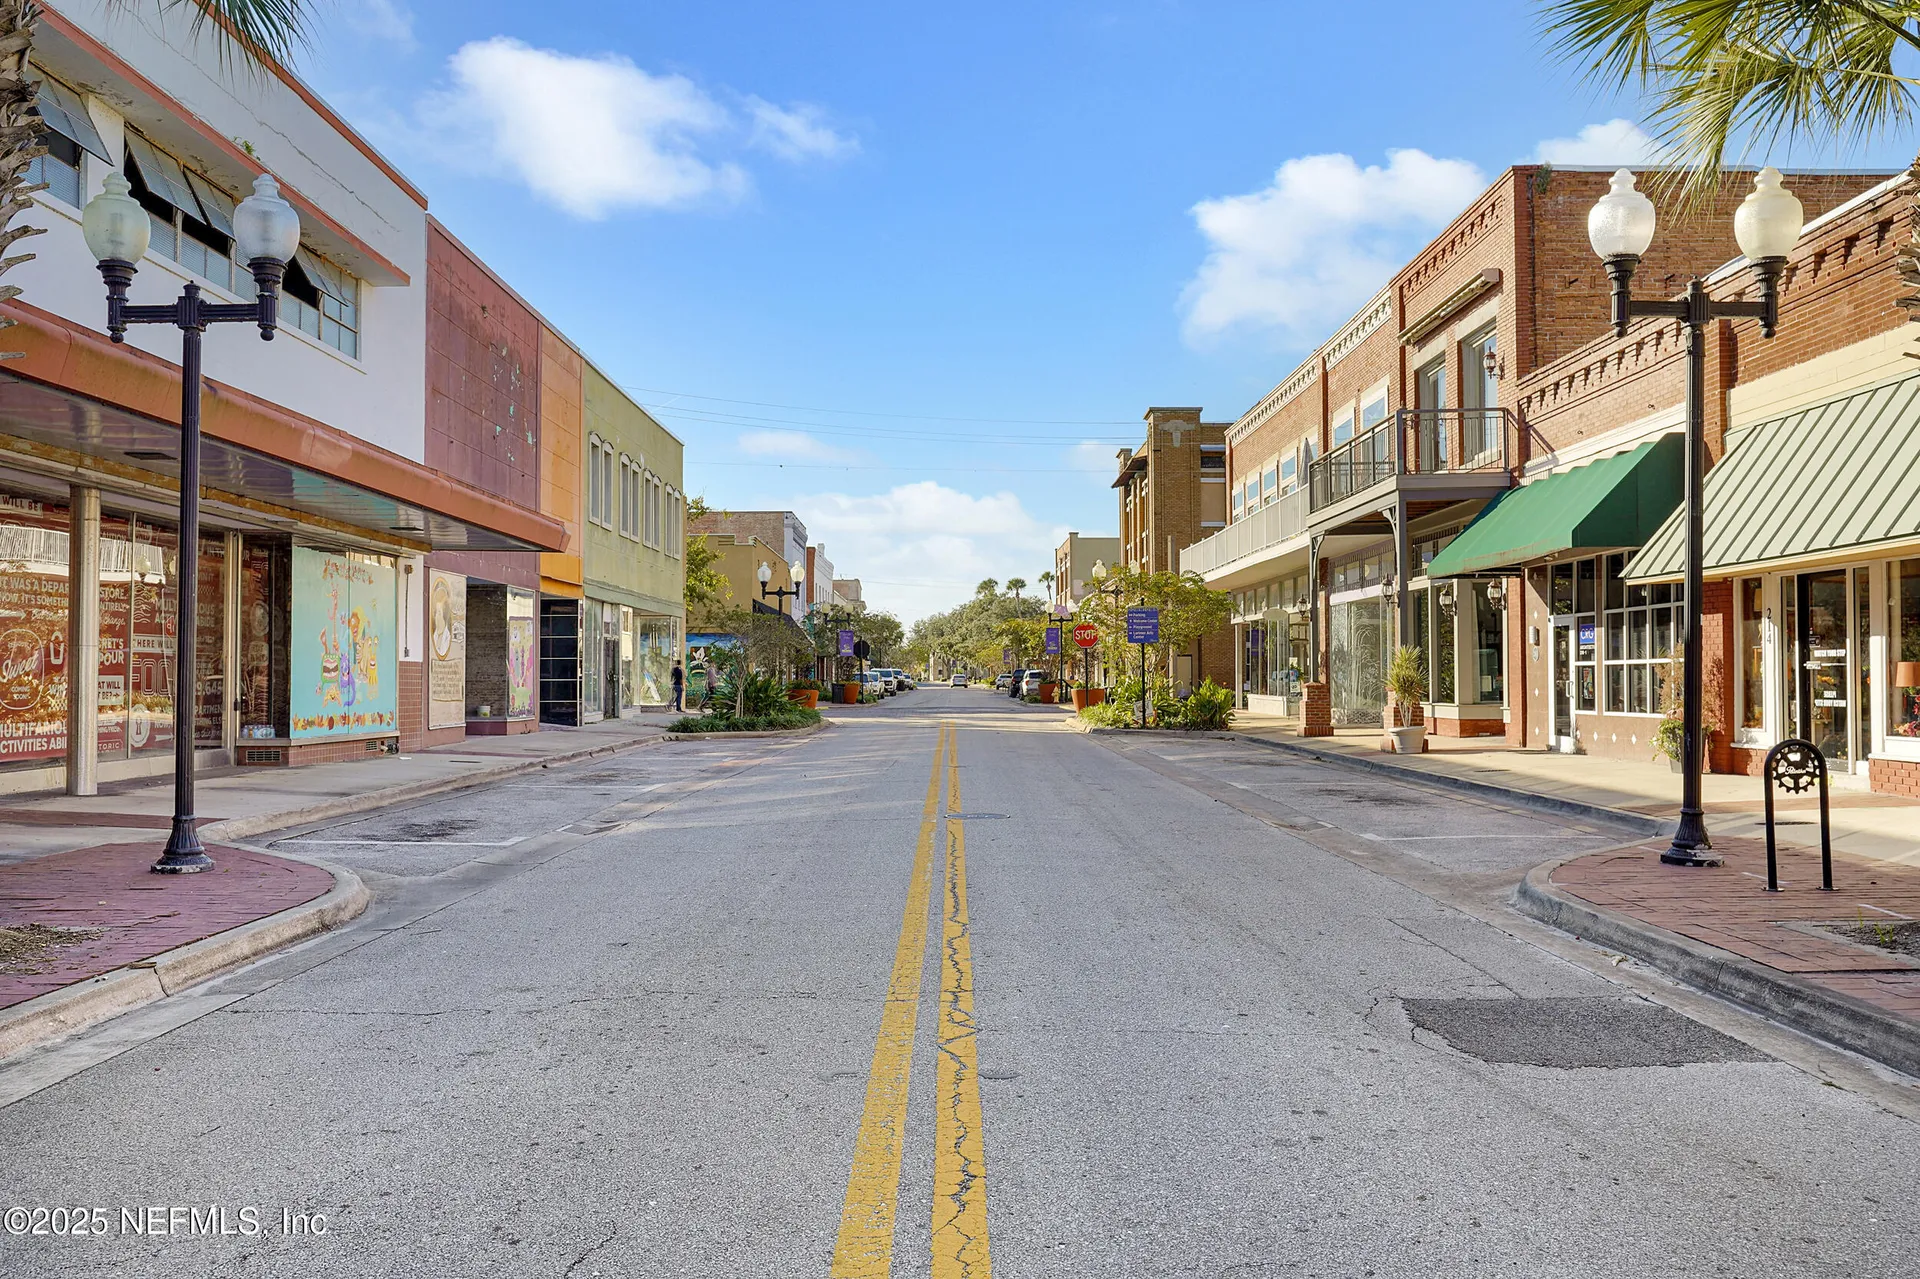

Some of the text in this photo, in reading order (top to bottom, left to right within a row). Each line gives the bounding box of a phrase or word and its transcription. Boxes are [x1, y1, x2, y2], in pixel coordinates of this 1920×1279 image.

[28, 500, 39, 511] BE
[11, 577, 31, 591] WAS
[33, 579, 40, 591] A
[1075, 629, 1096, 640] STOP
[106, 681, 121, 690] WILL
